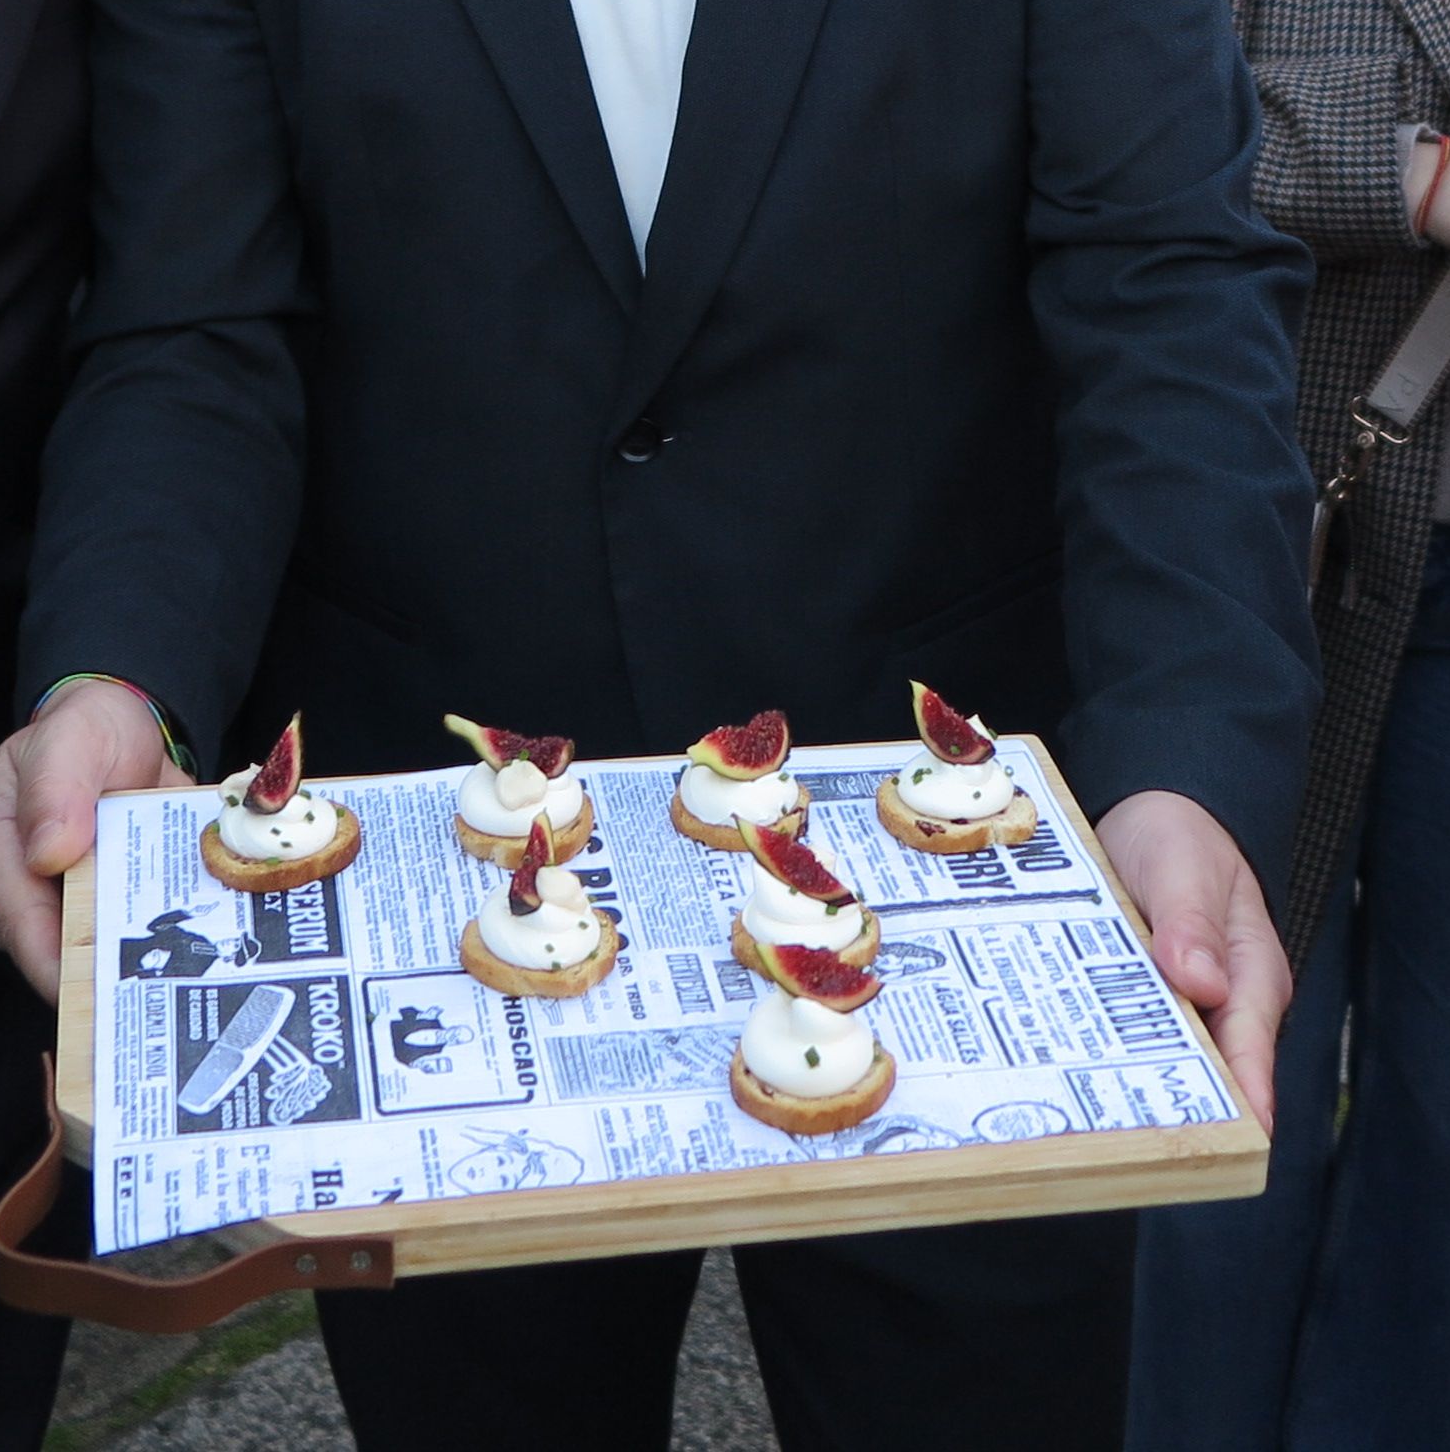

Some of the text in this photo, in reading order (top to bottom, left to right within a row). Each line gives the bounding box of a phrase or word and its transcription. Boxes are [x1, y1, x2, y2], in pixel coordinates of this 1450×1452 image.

[705, 849, 736, 902] LLEZA
[946, 847, 1018, 891] RRY
[264, 891, 282, 913] LY
[287, 880, 330, 954] SERUM
[145, 982, 167, 1040] ACADEMIA
[1082, 961, 1191, 1055] ENGLEBERT
[145, 1044, 168, 1081] MISOL
[501, 995, 538, 1087] HOSCAO
[1154, 1064, 1203, 1127] MAR
[311, 1168, 344, 1210] Ha
